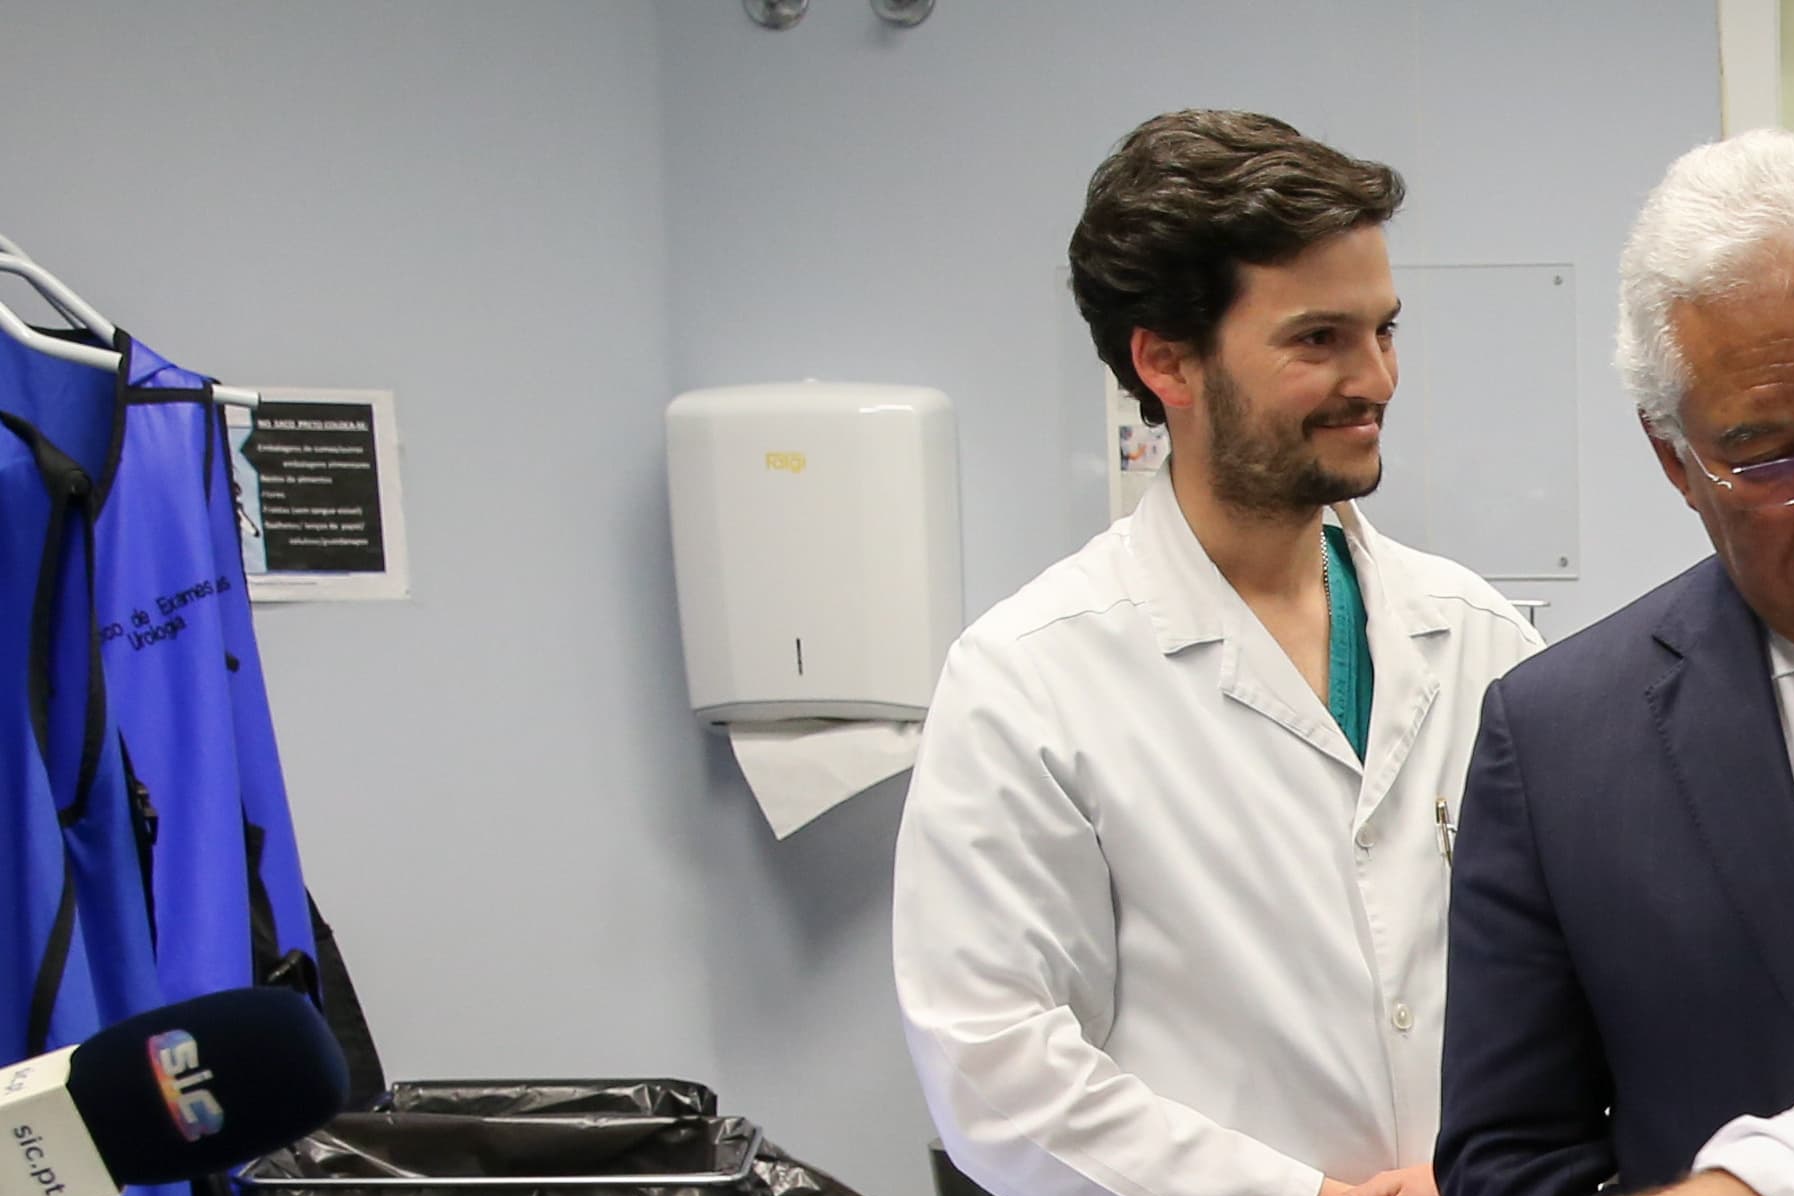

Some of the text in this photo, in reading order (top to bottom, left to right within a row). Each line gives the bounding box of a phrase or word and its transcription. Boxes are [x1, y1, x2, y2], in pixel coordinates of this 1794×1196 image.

[131, 608, 150, 629] de
[156, 580, 214, 617] Exames
[127, 615, 187, 651] Urologia
[13, 1124, 66, 1196] sic.pt
